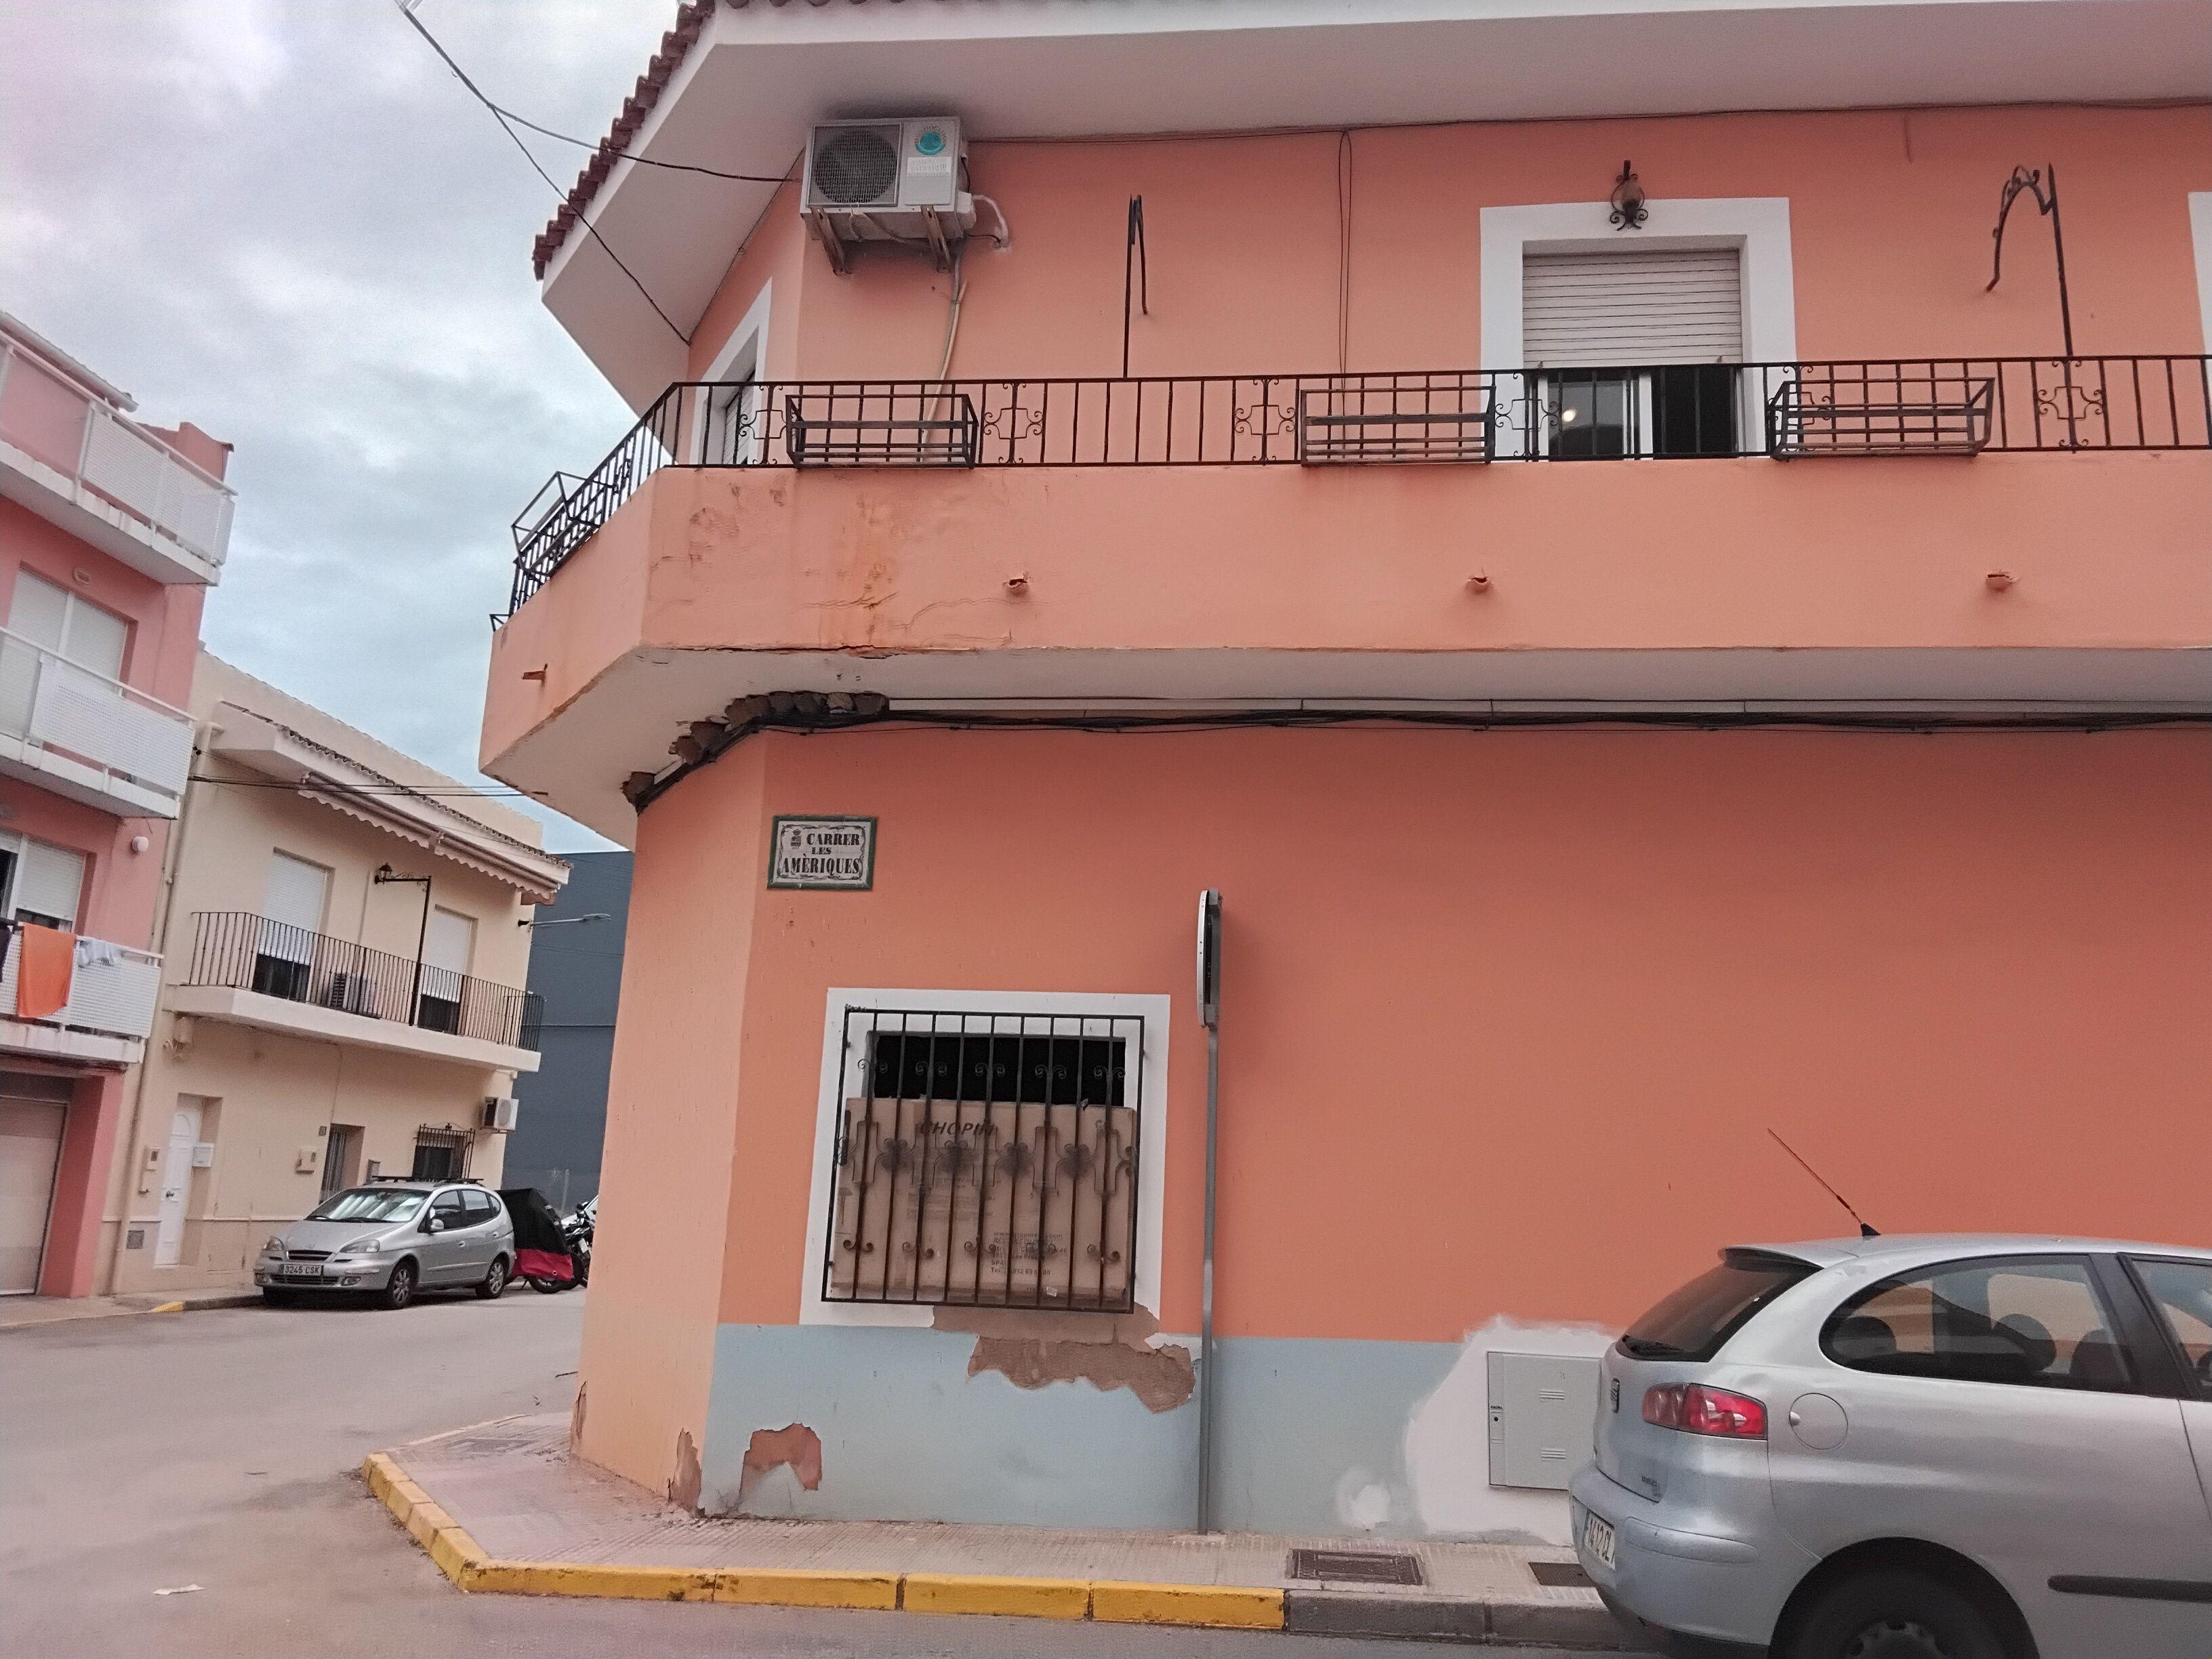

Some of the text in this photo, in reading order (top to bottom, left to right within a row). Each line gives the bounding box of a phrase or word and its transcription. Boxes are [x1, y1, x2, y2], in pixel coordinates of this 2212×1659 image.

[806, 833, 860, 846] CARRER
[811, 846, 832, 855] LES
[783, 853, 861, 875] AMÈRIQUES
[285, 1265, 303, 1274] 3245
